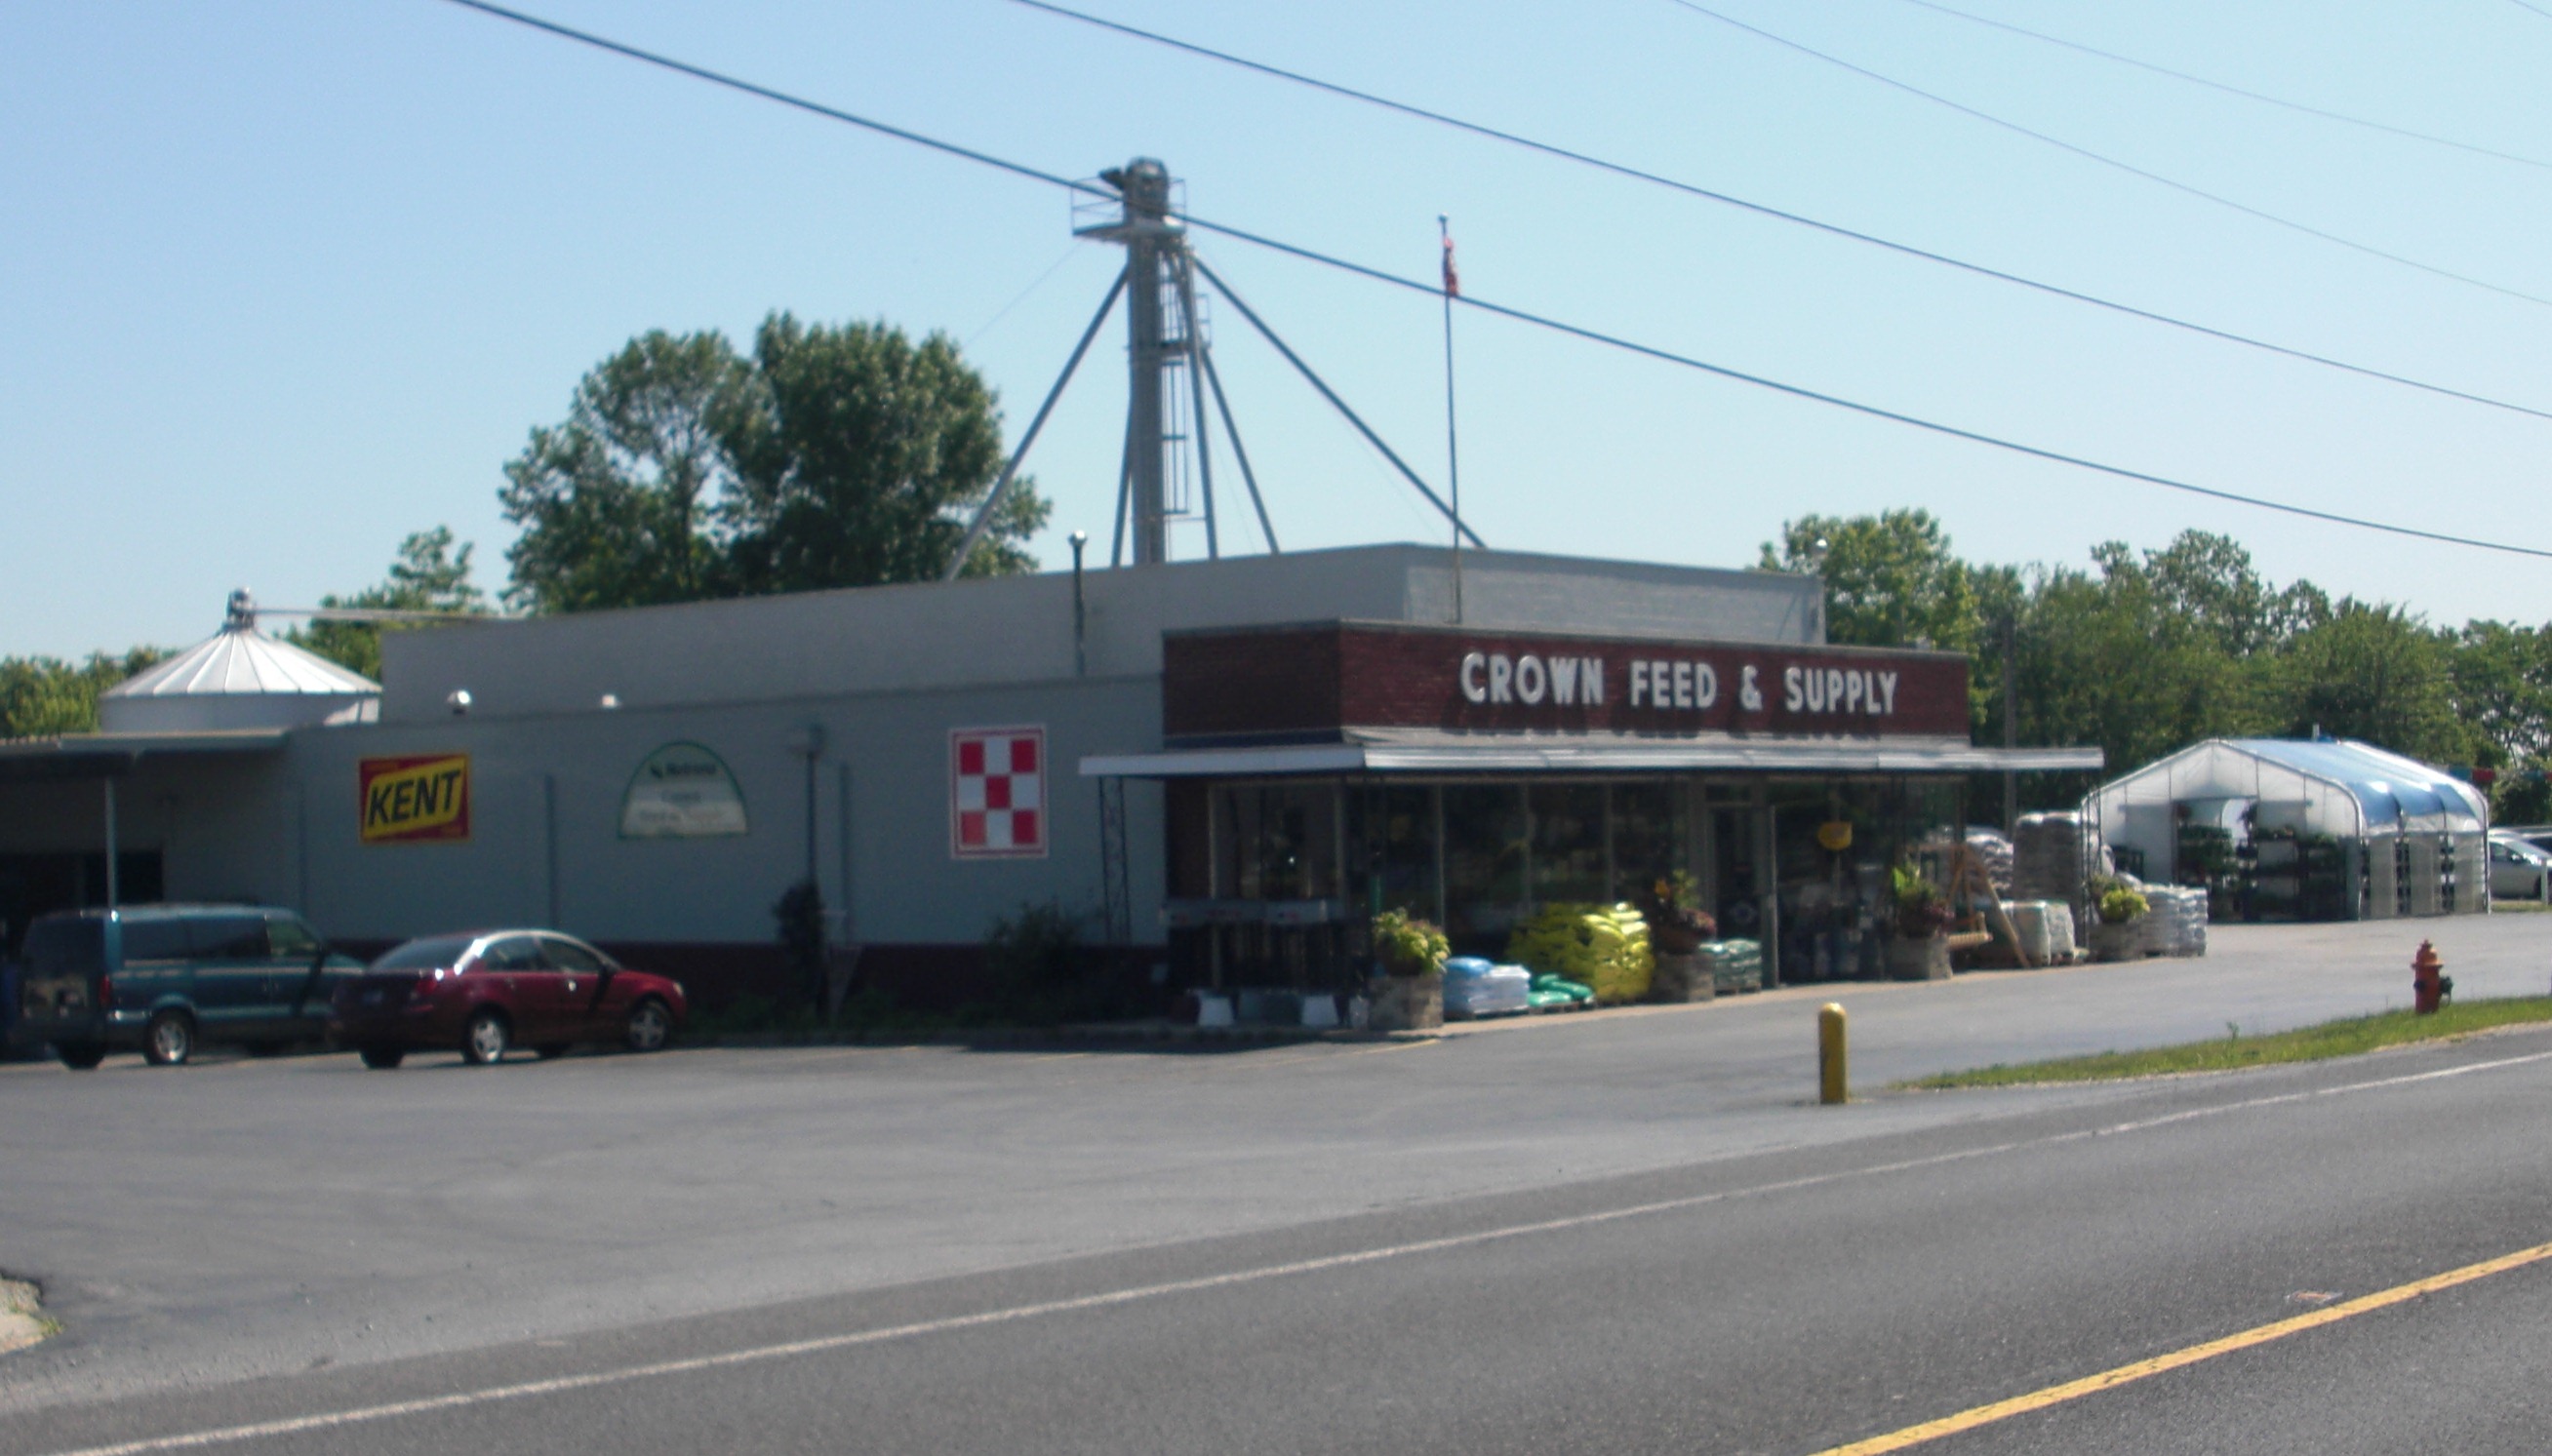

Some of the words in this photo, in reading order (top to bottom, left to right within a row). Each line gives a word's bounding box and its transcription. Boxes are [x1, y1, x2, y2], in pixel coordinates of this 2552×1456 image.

[1461, 651, 1604, 705] CROWN
[1630, 660, 1718, 708] FEED
[1741, 664, 1763, 710] &
[1785, 667, 1897, 714] SUPPLY
[369, 769, 460, 827] KENT
